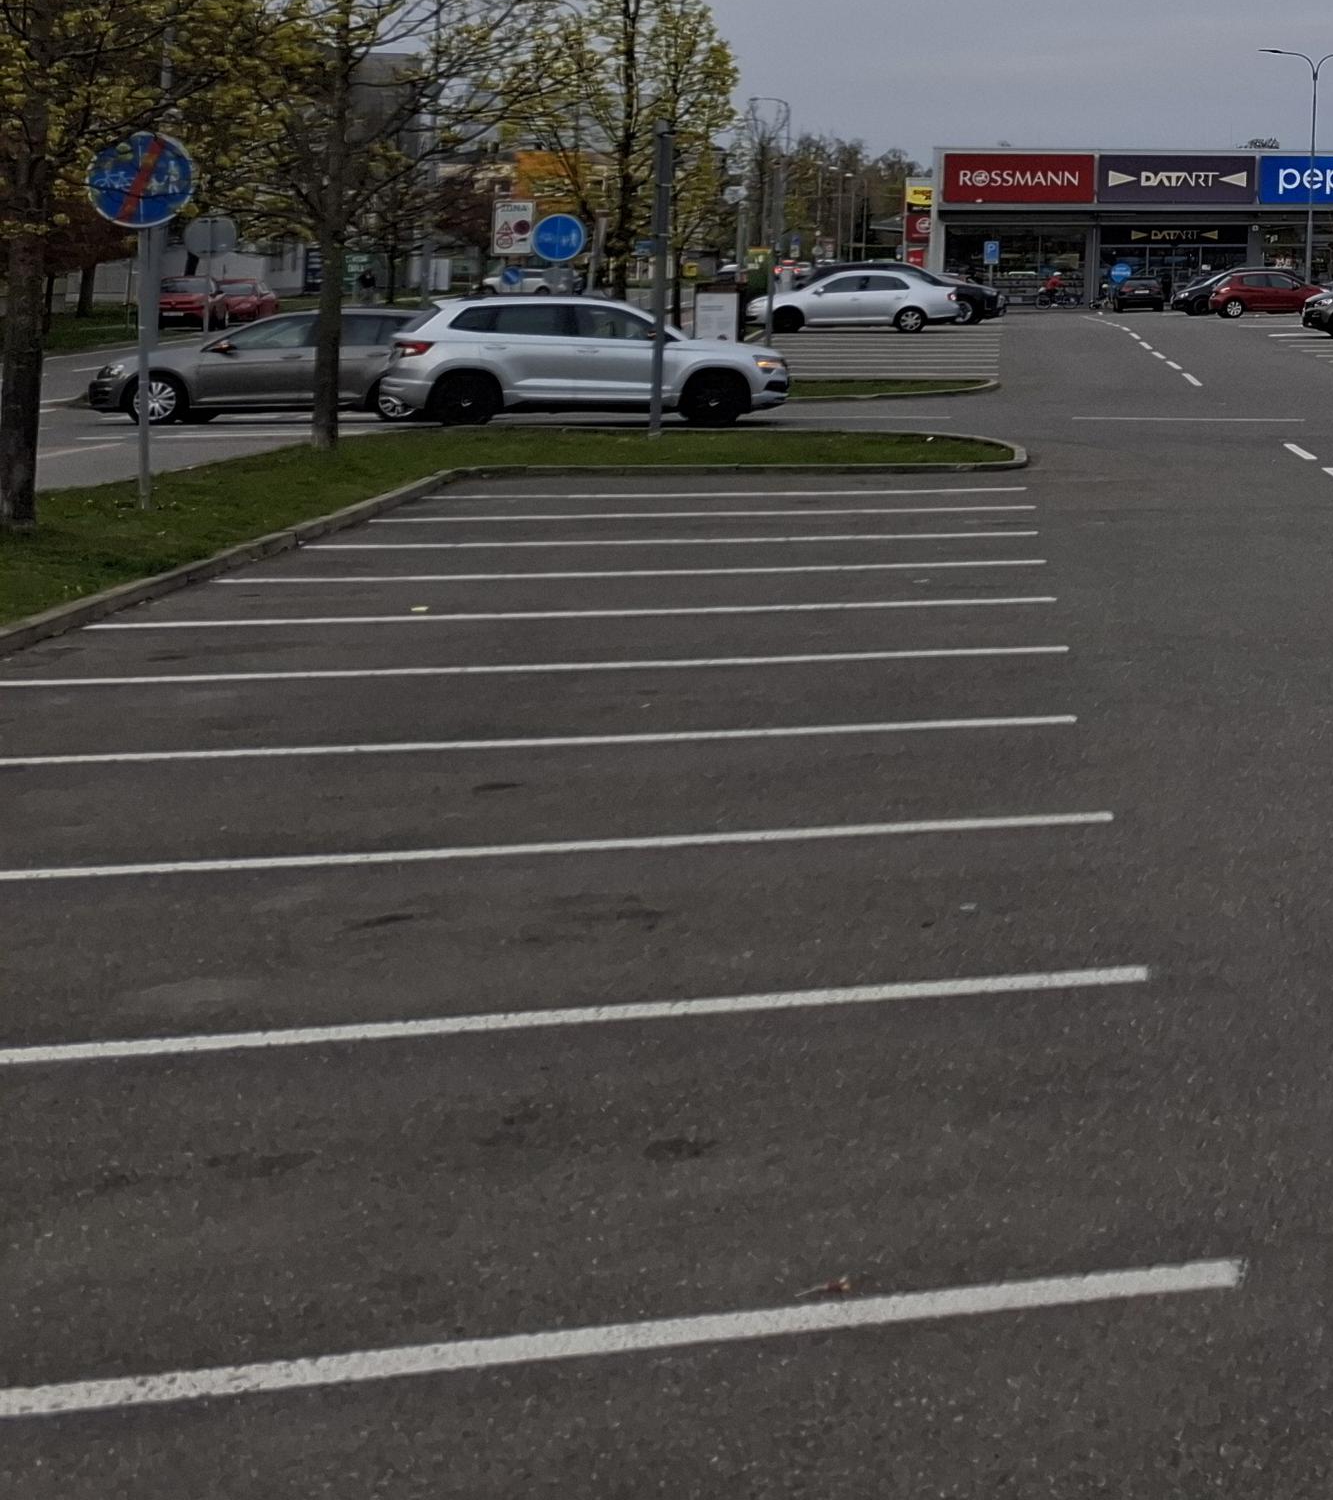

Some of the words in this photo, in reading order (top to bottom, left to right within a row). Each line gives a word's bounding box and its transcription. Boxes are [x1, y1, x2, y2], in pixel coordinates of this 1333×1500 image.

[959, 170, 1079, 187] ROSSMANN
[1140, 171, 1220, 187] DATART
[1151, 230, 1201, 240] DATART
